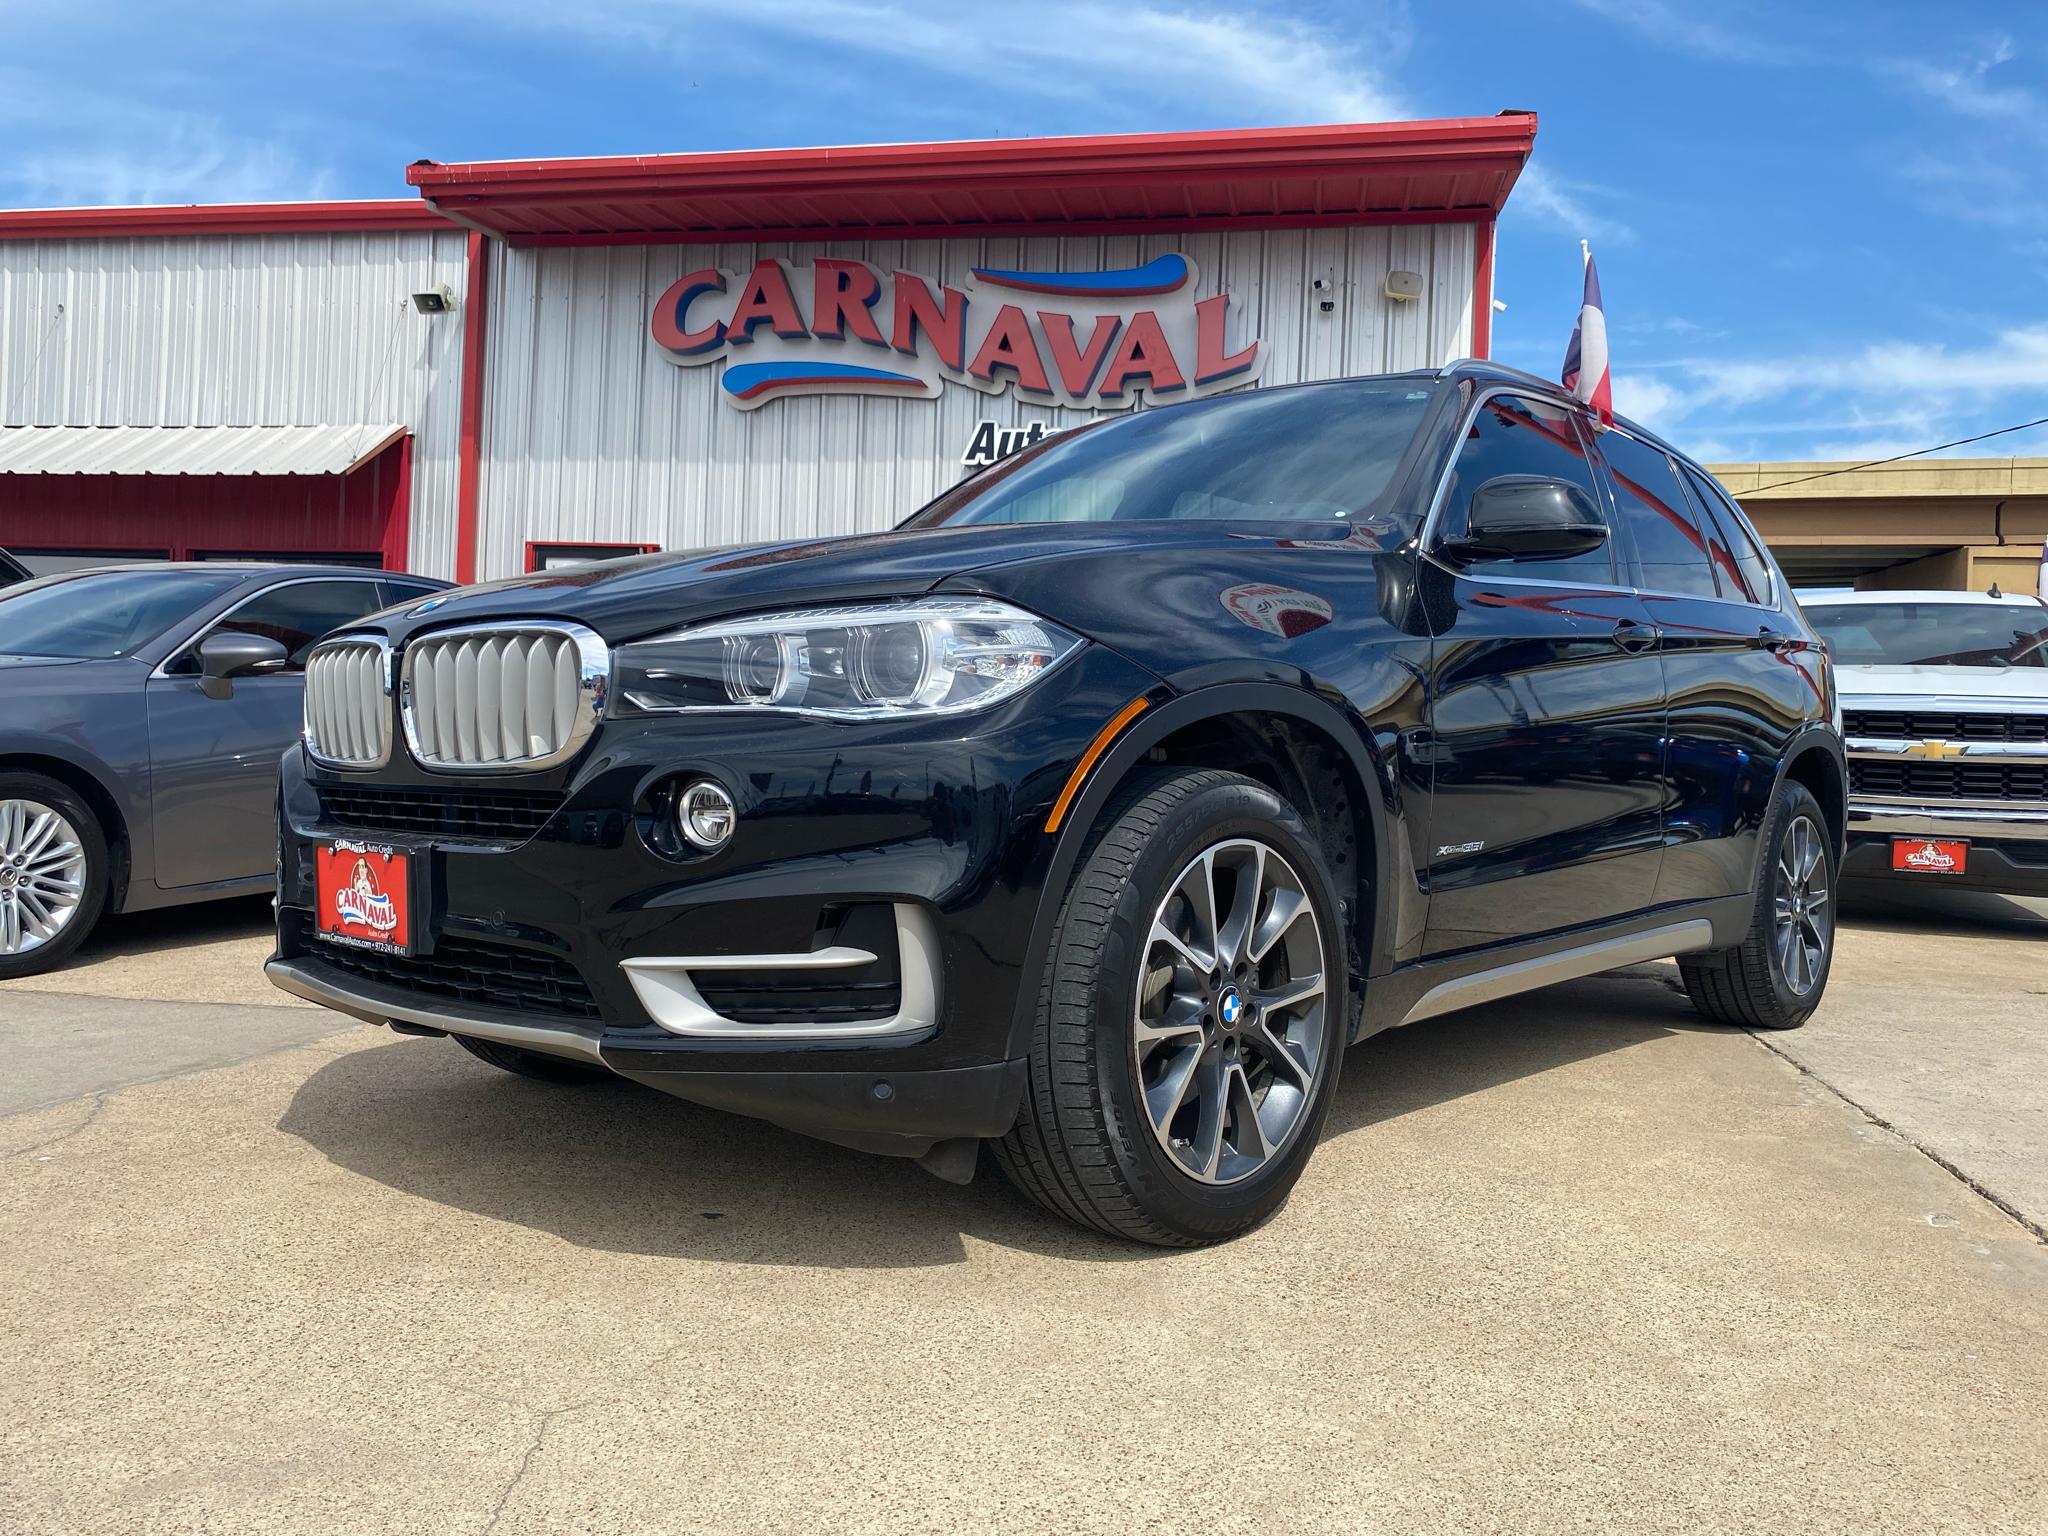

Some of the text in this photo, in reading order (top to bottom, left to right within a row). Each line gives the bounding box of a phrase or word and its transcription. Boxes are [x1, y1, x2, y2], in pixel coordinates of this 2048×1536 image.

[652, 257, 1258, 398] CARNAVAL
[965, 422, 1056, 461] Aut
[334, 839, 393, 855] CARNAVAL Auto Credit
[1906, 853, 1954, 866] CARNAVAL
[336, 888, 396, 926] CARNAVAL
